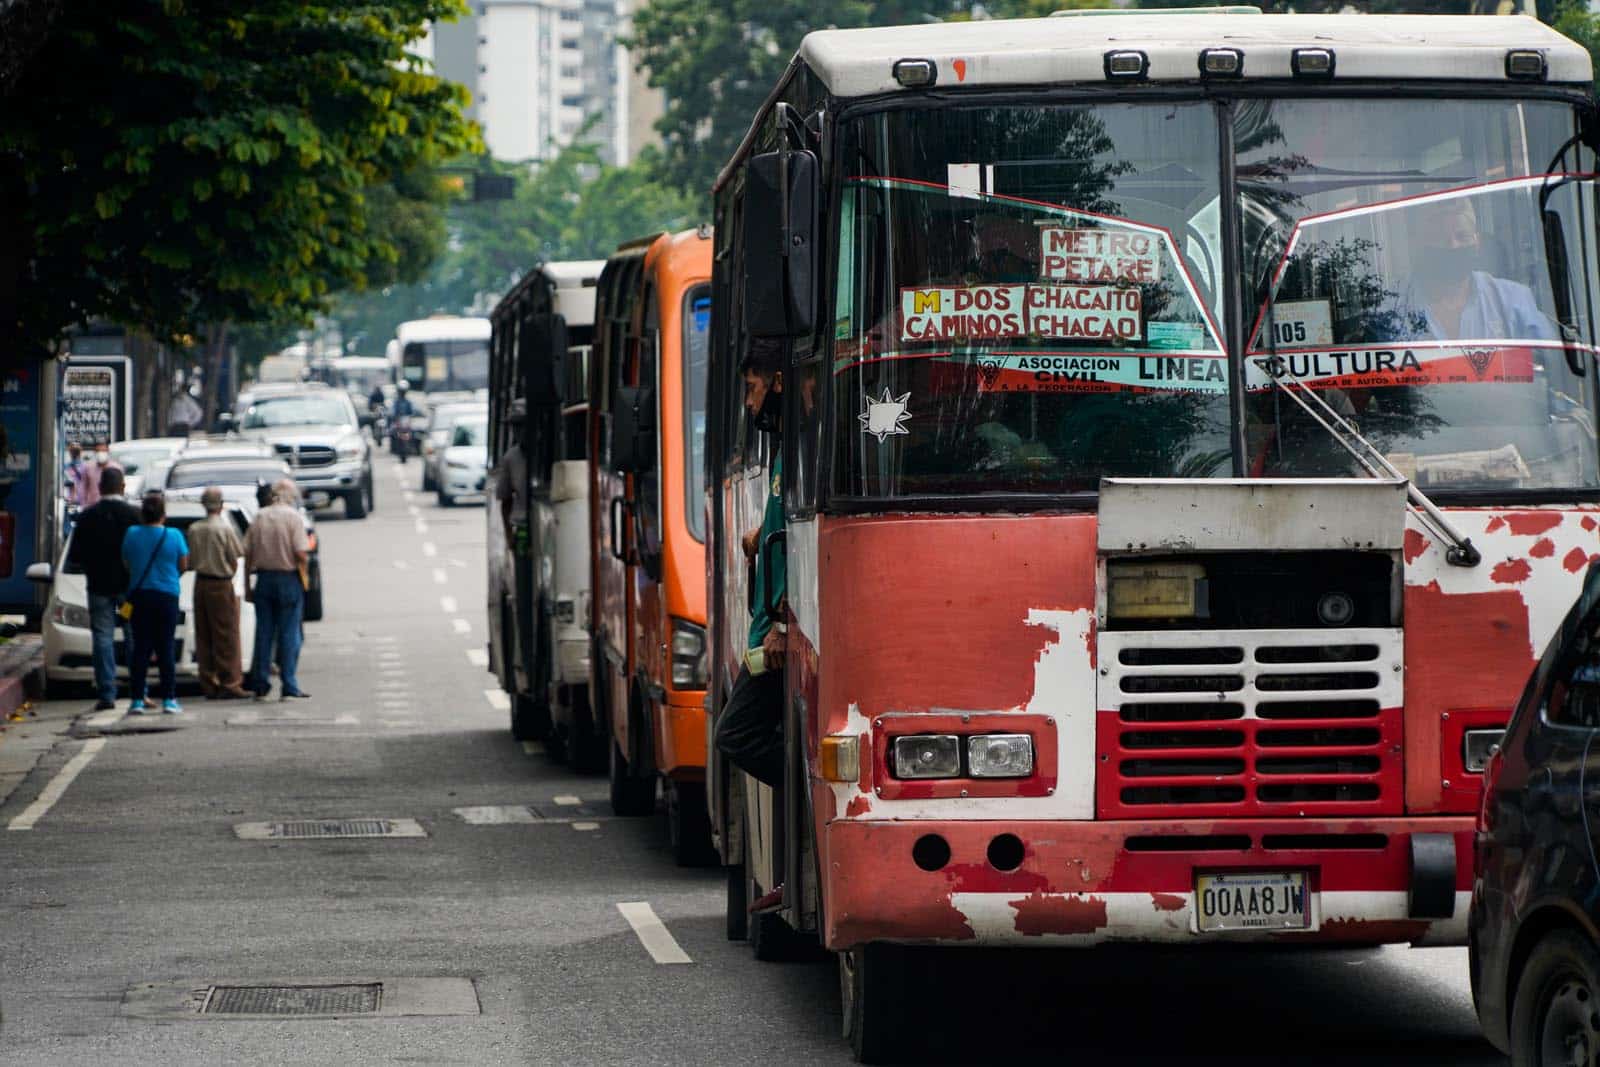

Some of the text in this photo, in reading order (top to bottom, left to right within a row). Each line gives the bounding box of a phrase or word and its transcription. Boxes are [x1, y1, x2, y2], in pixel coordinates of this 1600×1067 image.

[1049, 230, 1149, 254] METRO
[1045, 255, 1154, 281] PETARE
[1028, 287, 1139, 312] CHACAITO
[905, 313, 1020, 339] CAMINOS
[1034, 316, 1136, 338] CHACAO
[1018, 357, 1120, 371] ASOCIACION
[1138, 350, 1423, 383] LINEA CULTURA
[1034, 370, 1105, 383] CIVIL
[1358, 377, 1389, 386] AUTOS
